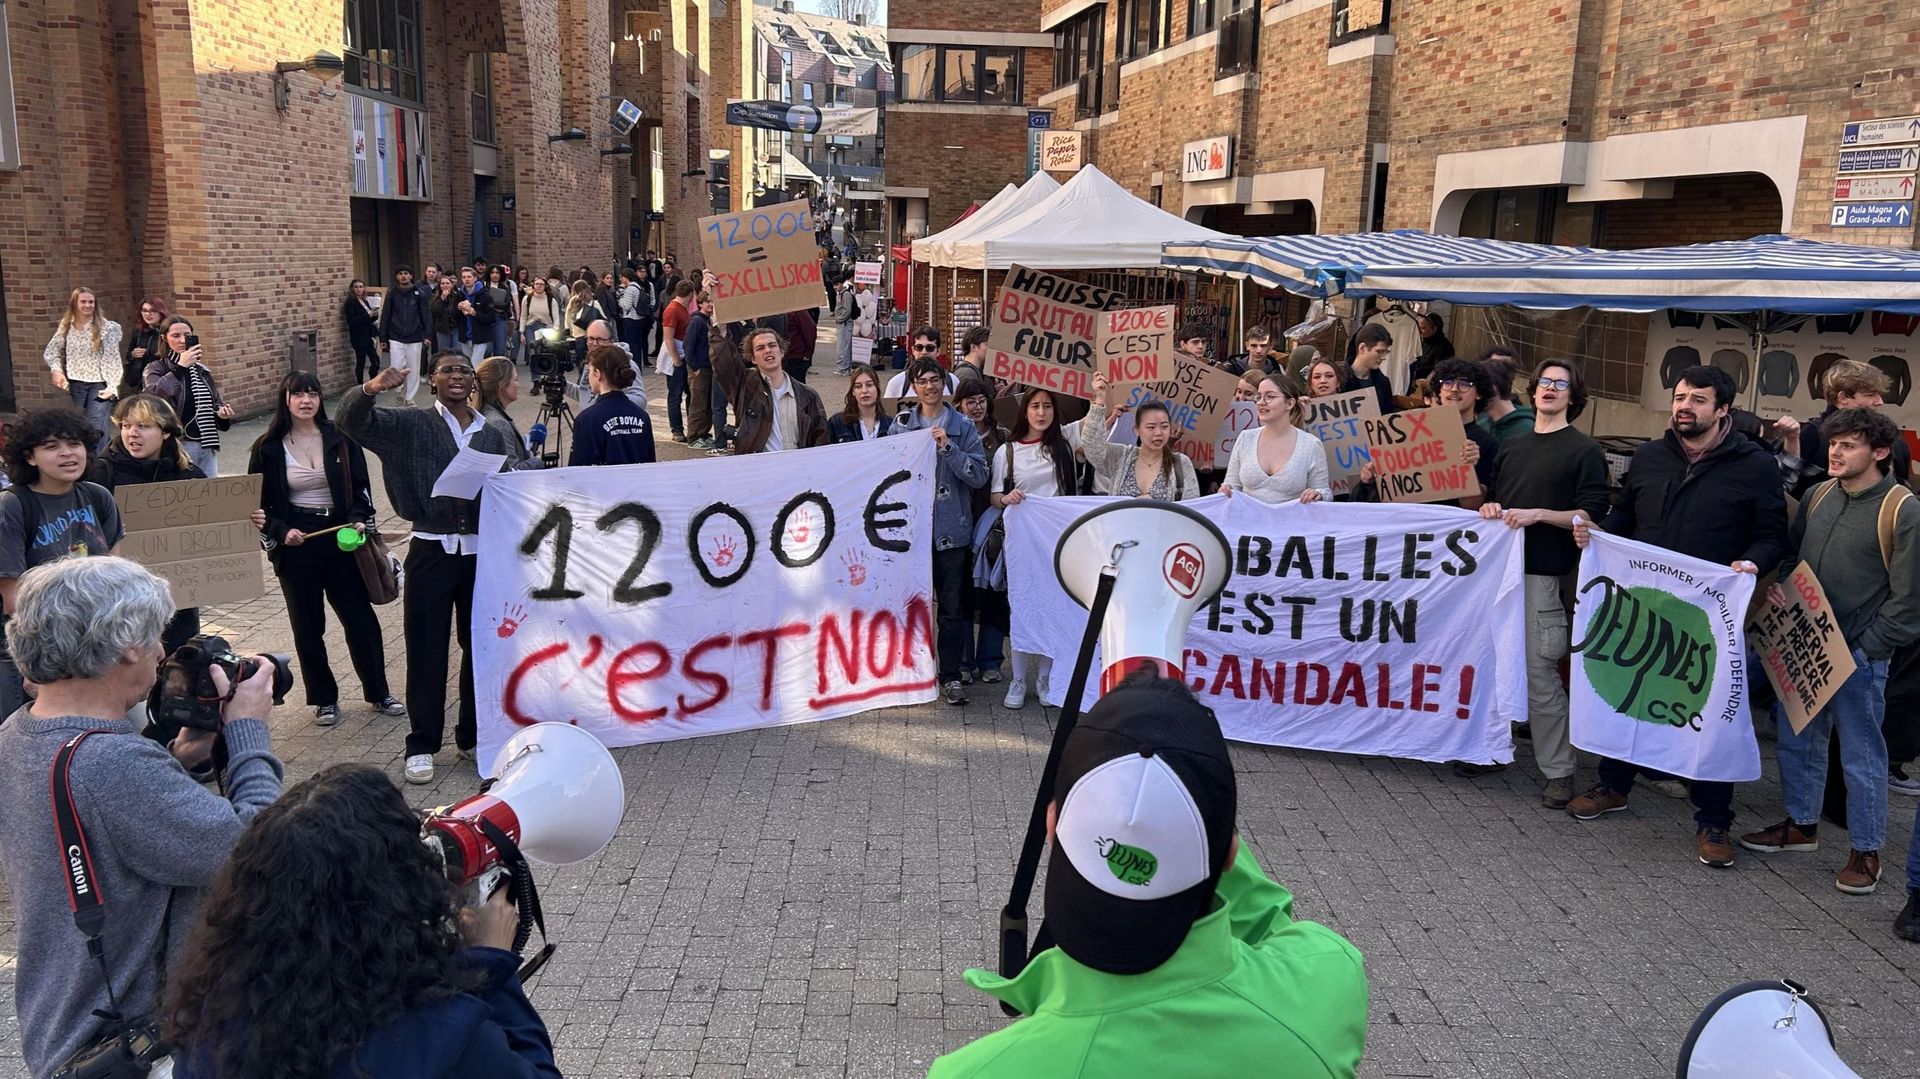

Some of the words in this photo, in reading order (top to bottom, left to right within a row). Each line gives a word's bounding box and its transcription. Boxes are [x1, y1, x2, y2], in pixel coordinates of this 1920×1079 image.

[1052, 135, 1076, 147] Rice
[1844, 134, 1857, 143] UCL
[1879, 122, 1887, 130] des
[1046, 144, 1077, 157] Paper
[1050, 154, 1075, 167] Rolls
[1187, 149, 1208, 173] ING
[1860, 188, 1894, 196] MAGNA
[1849, 215, 1892, 225] Grand-place
[1850, 206, 1867, 214] Aula
[1867, 205, 1893, 216] Magna
[716, 258, 821, 299] EXCLUSION
[1000, 291, 1094, 341] BRUTAL
[1109, 309, 1170, 334] 1200€
[1014, 328, 1093, 368] FUTUR
[1104, 333, 1165, 355] C'EST
[1820, 344, 1846, 352] Burgundy
[993, 351, 1097, 400] BANCAL
[1108, 353, 1159, 384] NON
[1184, 387, 1218, 415] TON
[1364, 414, 1407, 446] PAS
[1369, 440, 1448, 475] TOUCHE
[1391, 472, 1423, 497] NOS
[164, 503, 208, 527] EST
[142, 531, 168, 557] UN
[179, 523, 240, 552] DROIT
[1235, 529, 1480, 582] BALLES
[174, 563, 200, 576] DES
[1176, 556, 1198, 580] AGL
[1339, 596, 1418, 644] UN
[1792, 572, 1820, 612] 1200
[1814, 611, 1835, 643] DE
[817, 594, 935, 695] NON
[1571, 575, 1712, 712] JEUNES
[1628, 558, 1694, 586] INFORMER
[1703, 586, 1737, 648] MOBILISER
[1720, 659, 1744, 724] DEFENDRE
[1766, 647, 1798, 702] BALLE
[1786, 627, 1823, 698] PREFERE
[1182, 648, 1475, 720] CANDALE!
[1796, 680, 1816, 716] UNE
[1647, 699, 1704, 732] CSC
[68, 844, 89, 895] Canon
[1099, 838, 1156, 877] JEUNES
[1128, 876, 1151, 887] CSC
